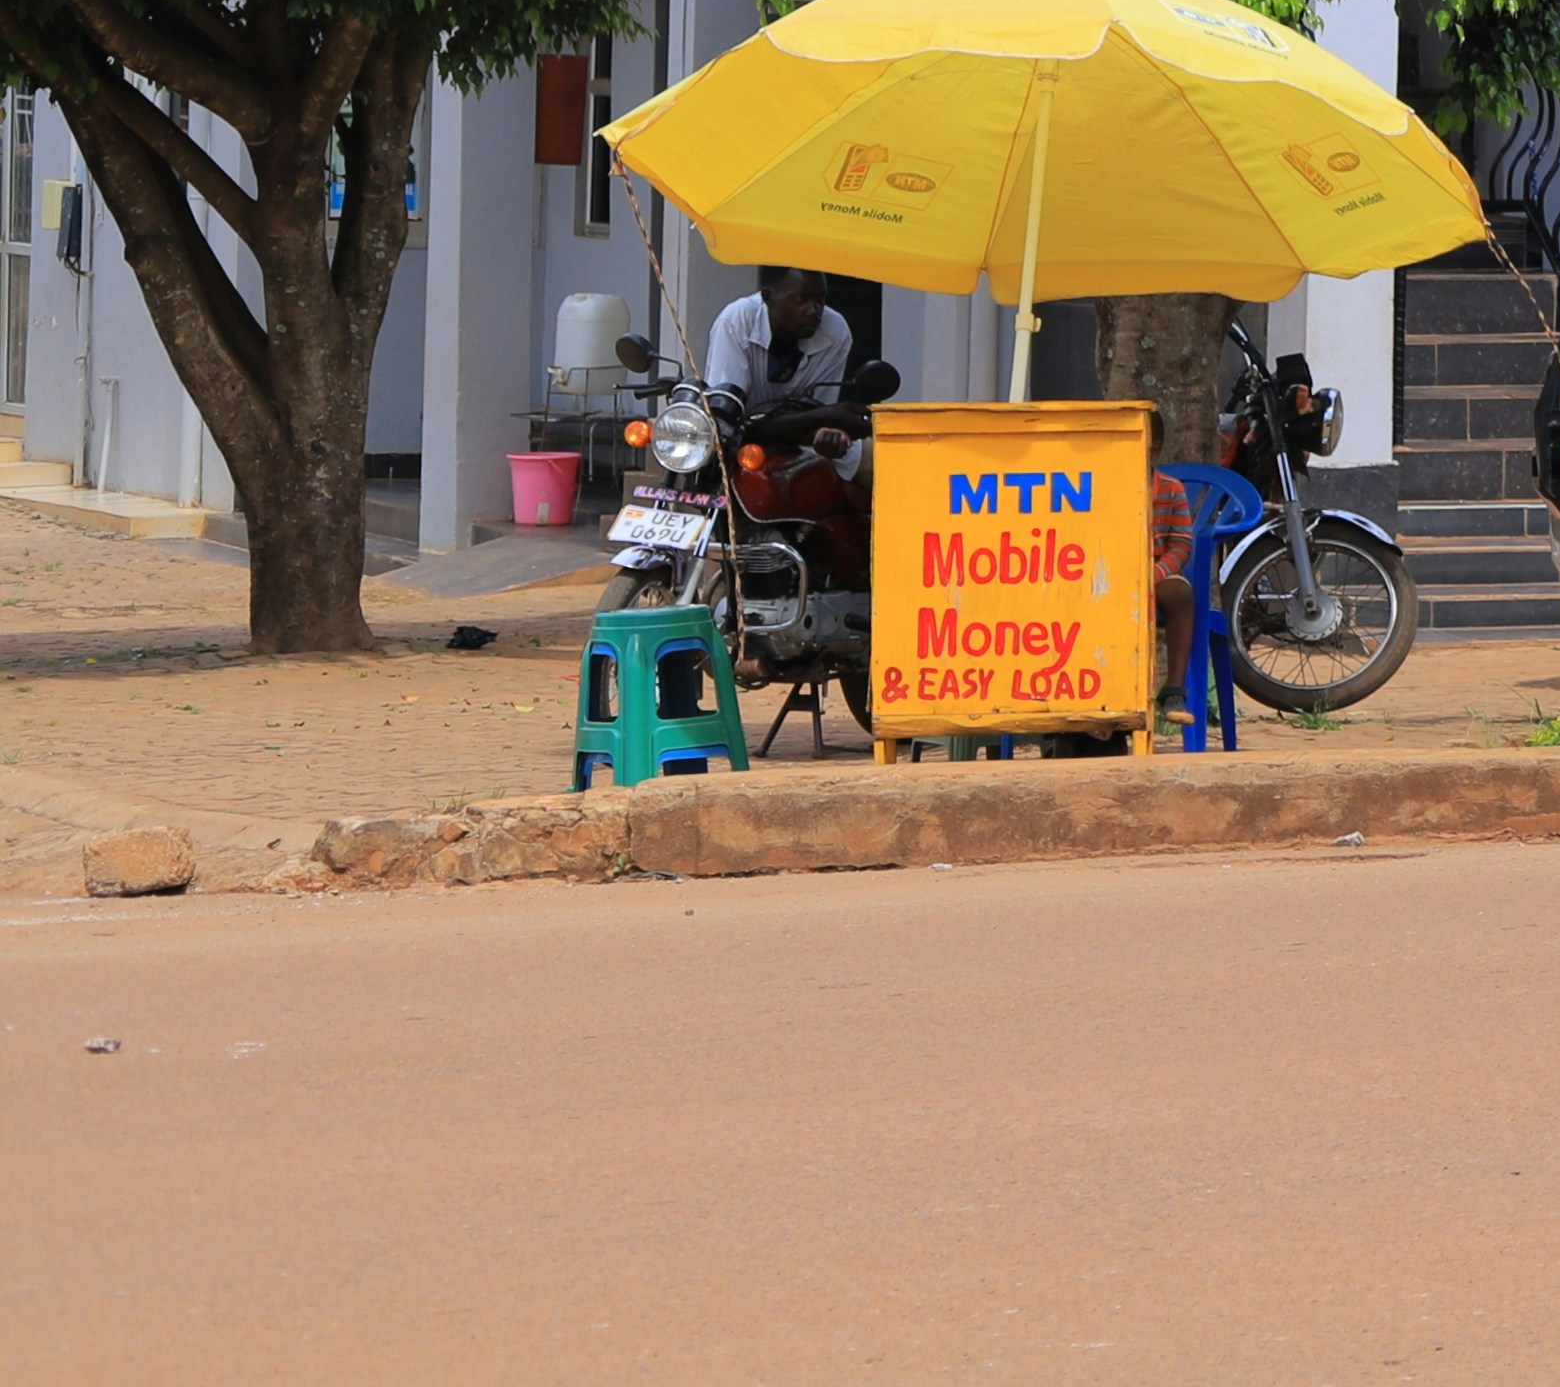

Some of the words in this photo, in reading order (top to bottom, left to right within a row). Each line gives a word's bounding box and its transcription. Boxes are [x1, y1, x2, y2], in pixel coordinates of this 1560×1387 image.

[949, 472, 1093, 515] MTN
[630, 525, 686, 543] 069U
[651, 512, 695, 530] UEY
[923, 528, 1086, 588] Mobile
[917, 607, 1082, 676] Money
[881, 666, 910, 703] &
[917, 667, 995, 701] EASY
[1010, 668, 1102, 701] LOAD
